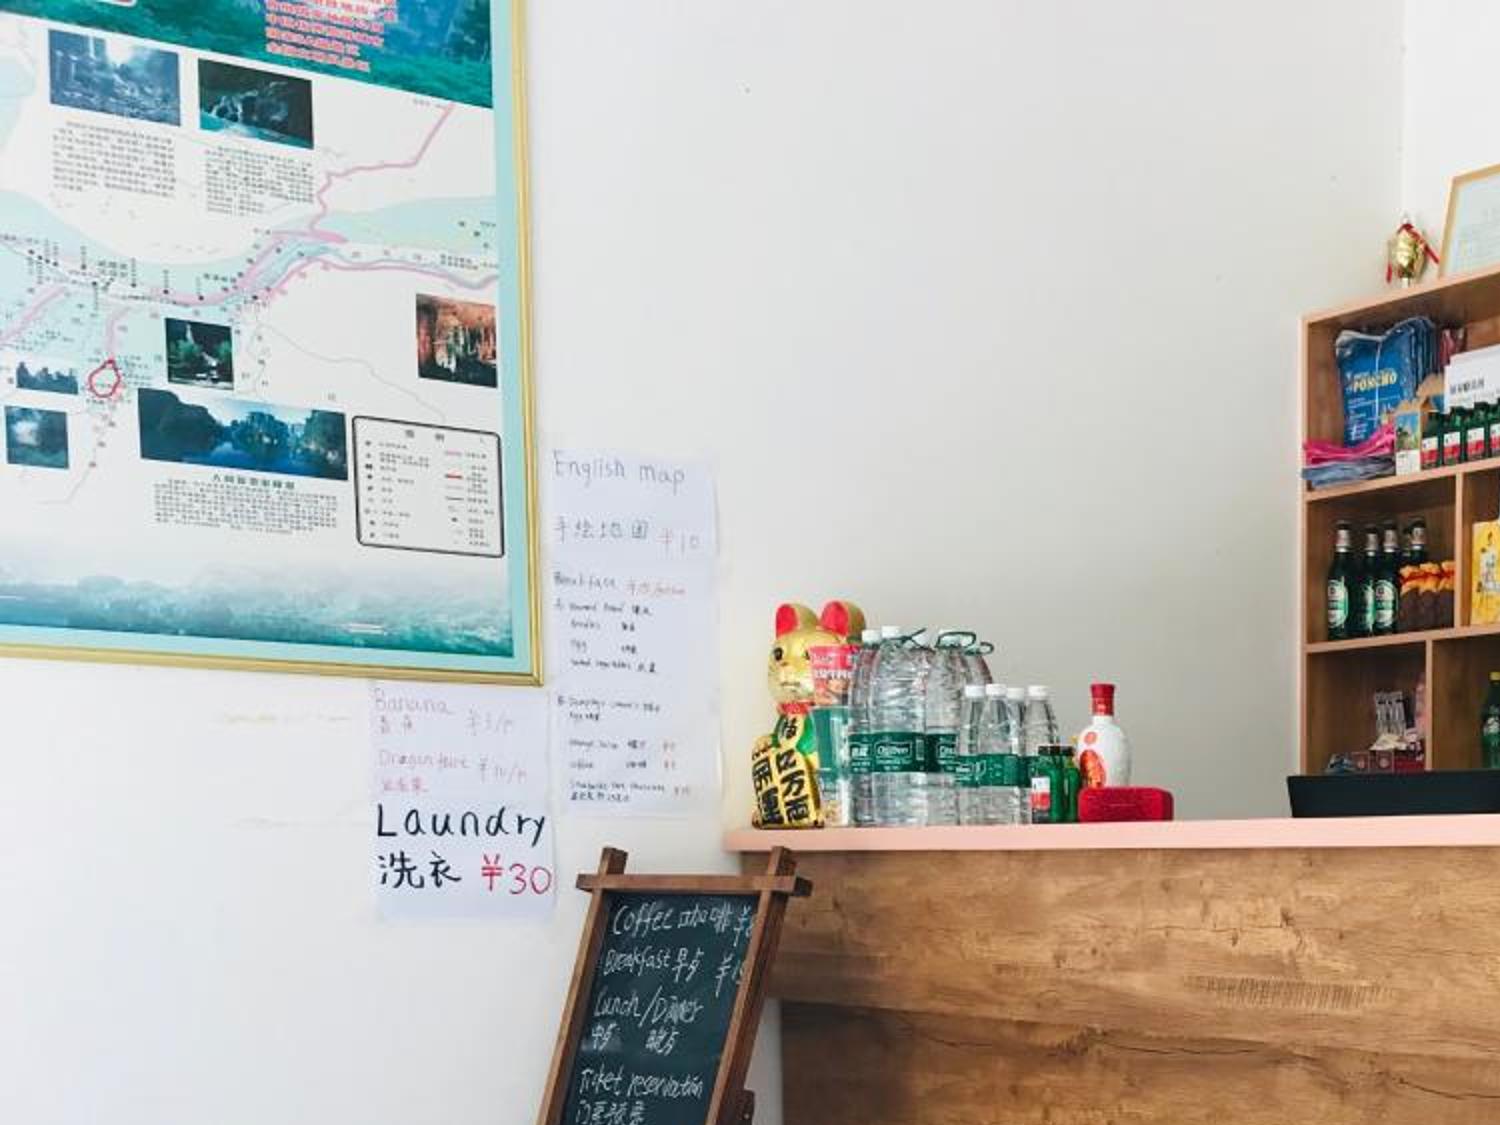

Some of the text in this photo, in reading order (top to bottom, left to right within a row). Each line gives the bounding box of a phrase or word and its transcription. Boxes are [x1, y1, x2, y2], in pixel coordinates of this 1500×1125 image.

[553, 449, 625, 488] English
[377, 803, 545, 848] Laundry
[378, 851, 552, 896] 洗衣 ¥30
[612, 901, 675, 937] Coffee
[603, 945, 671, 977] Breakfast
